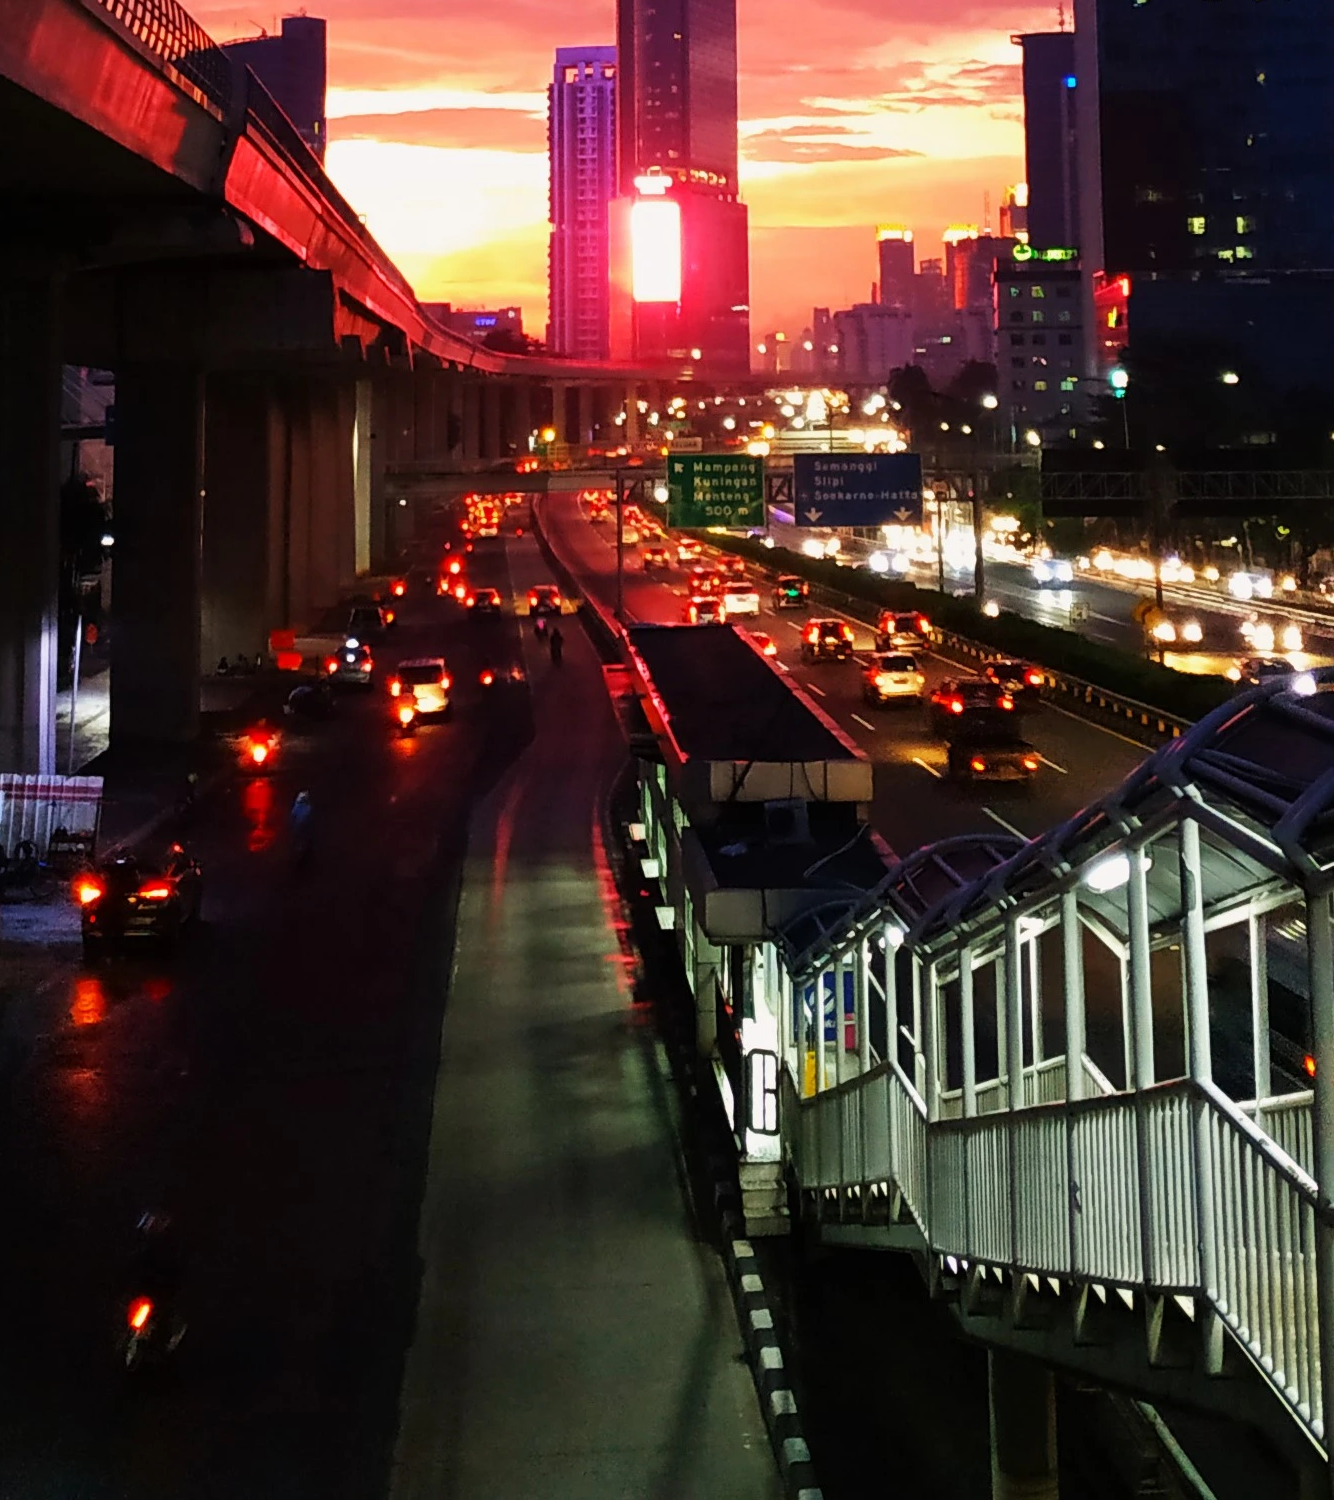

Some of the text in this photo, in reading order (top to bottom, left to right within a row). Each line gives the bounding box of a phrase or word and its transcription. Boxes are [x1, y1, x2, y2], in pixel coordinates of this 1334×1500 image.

[693, 461, 755, 474] Mampang
[814, 461, 877, 473] Semanggi
[693, 476, 757, 489] Kuningan
[814, 476, 844, 487] Slipi
[693, 491, 749, 504] Menteng
[705, 505, 749, 516] 500 m
